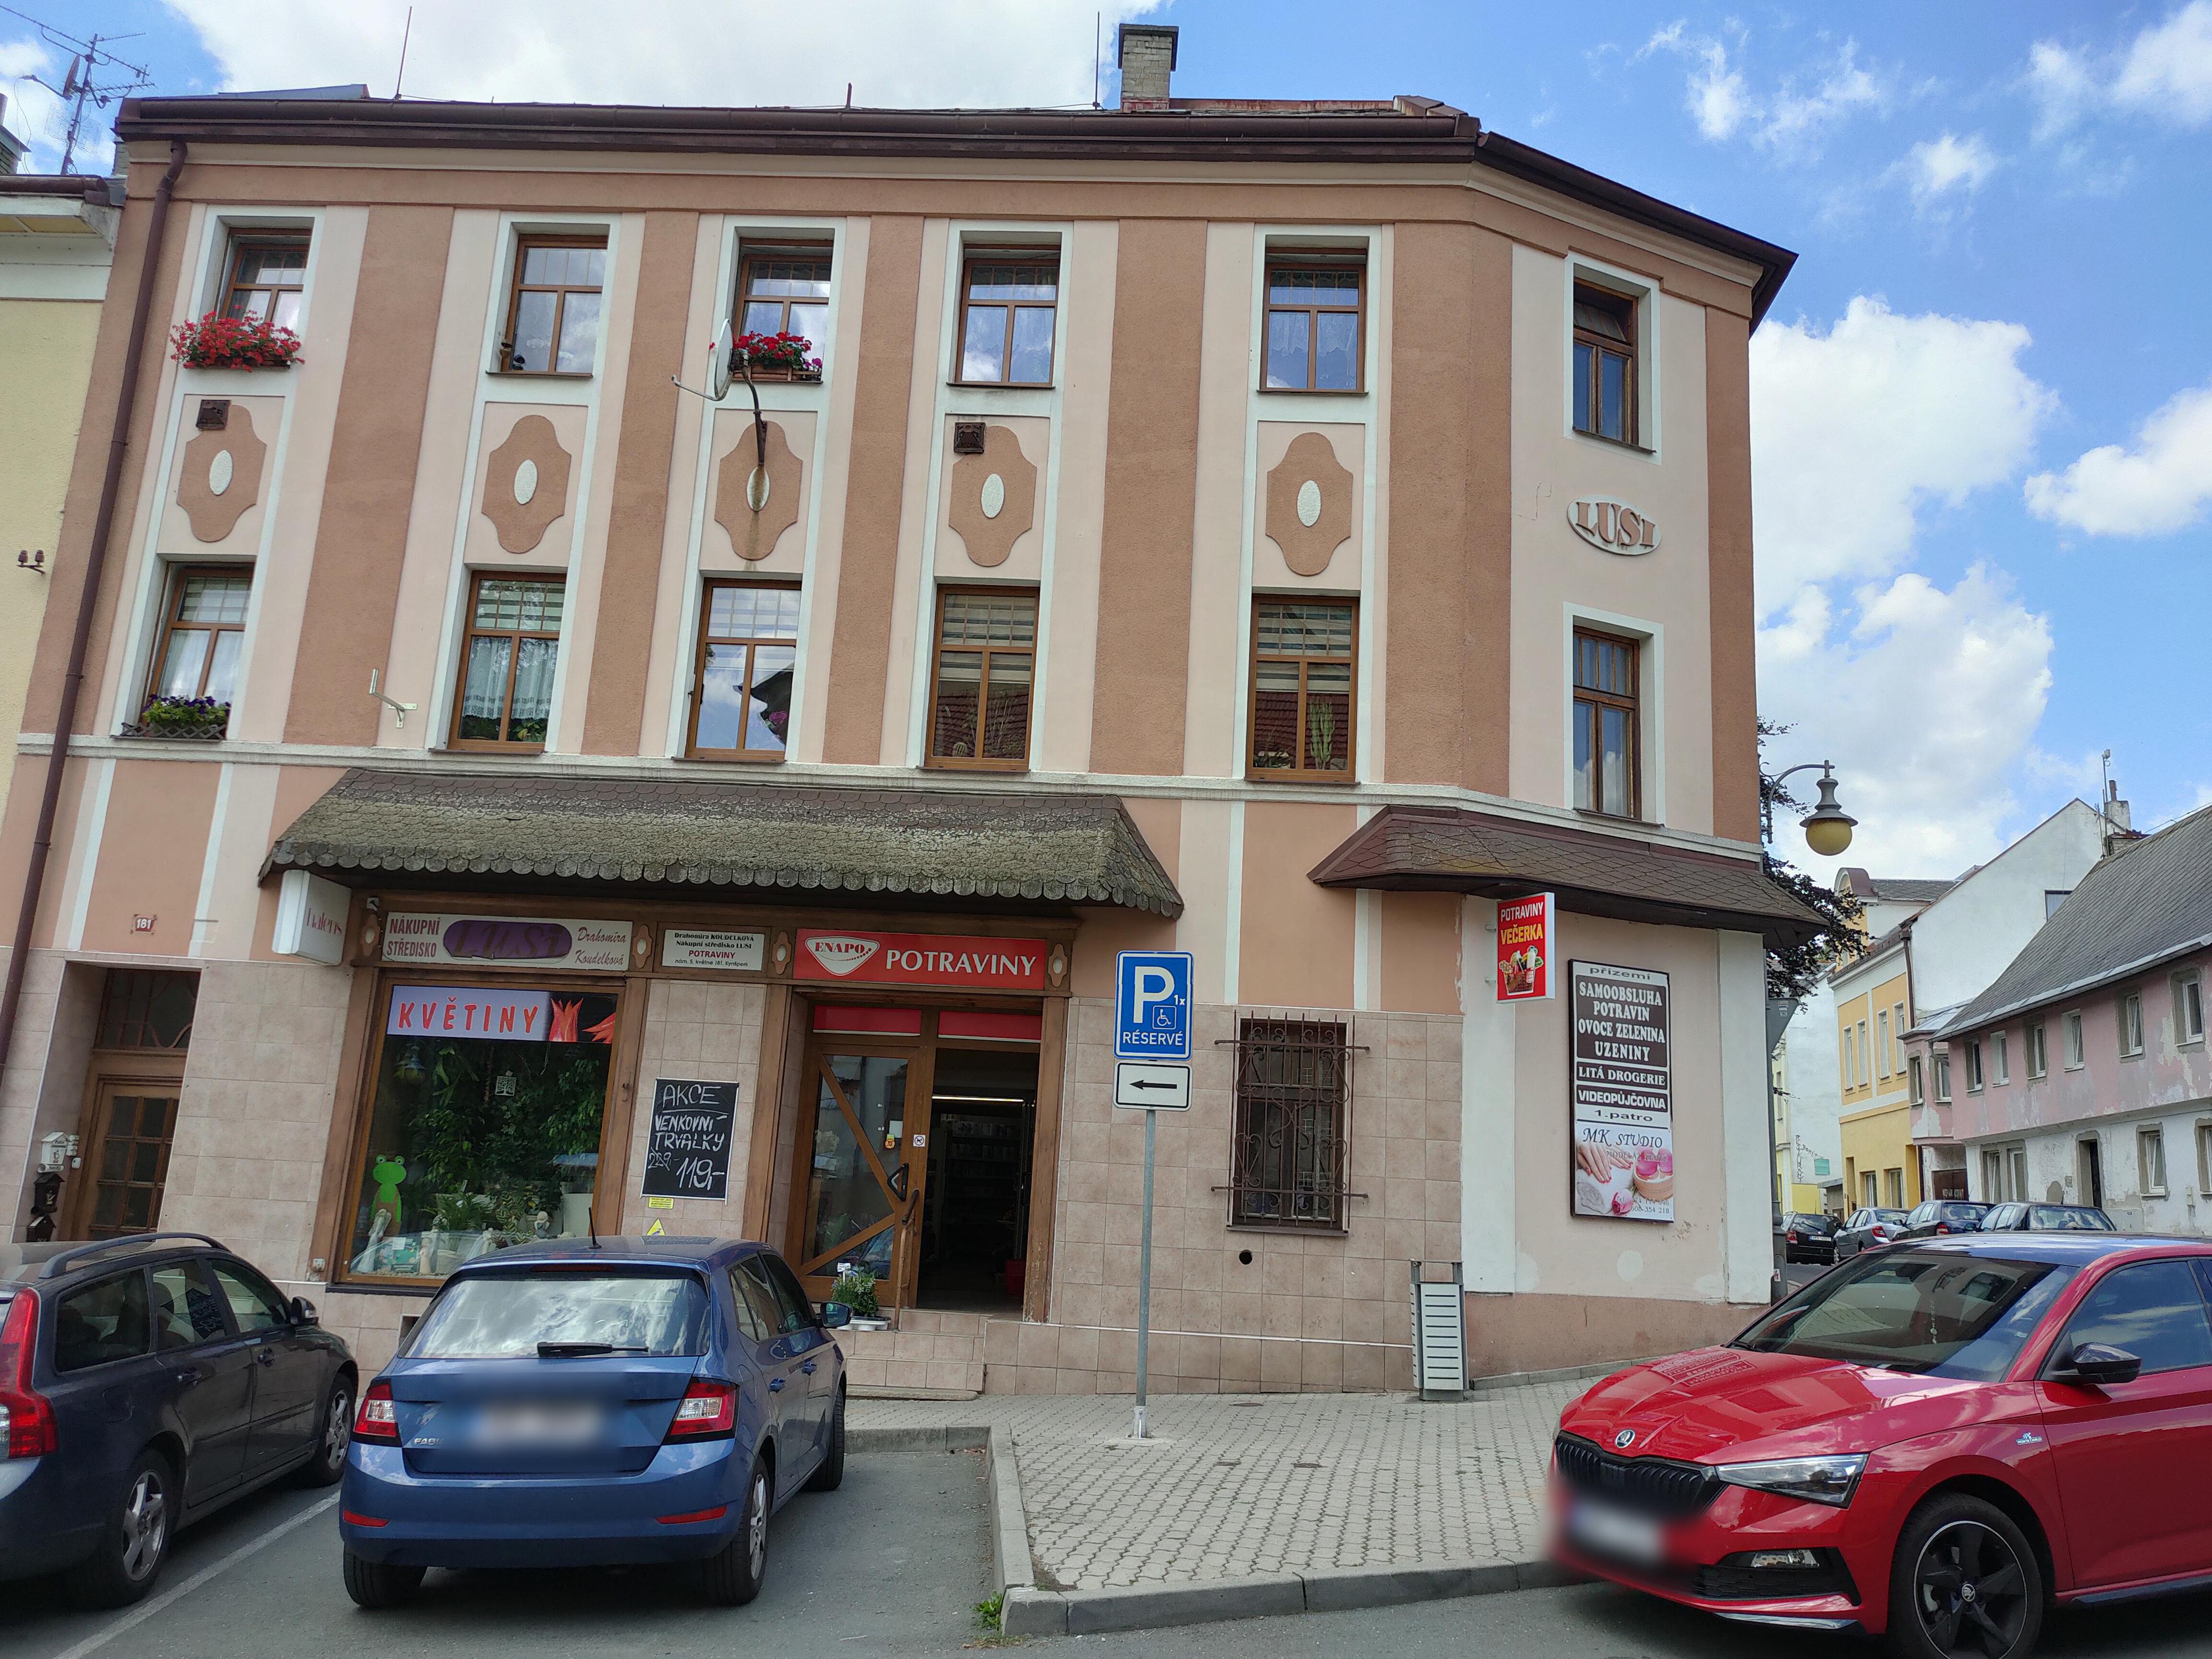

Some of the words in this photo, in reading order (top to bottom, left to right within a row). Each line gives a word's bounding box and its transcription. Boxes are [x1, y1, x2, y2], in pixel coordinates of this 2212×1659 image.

[1575, 502, 1656, 547] LUSI
[1500, 902, 1544, 922] POTRAVINY
[137, 918, 152, 929] 181
[389, 915, 441, 935] NÁKUPNÍ
[577, 926, 627, 943] Drahomíra
[1500, 923, 1543, 945] VEČERKA
[387, 938, 437, 958] STŘEDISKO
[575, 950, 624, 965] Koudelková
[688, 950, 736, 959] POTRAVINY
[814, 941, 866, 954] ENAPO
[886, 949, 1037, 976] POTRAVINY
[1590, 967, 1651, 980] přízemí
[1133, 966, 1175, 1024] P
[1173, 994, 1186, 1005] 1x
[1579, 981, 1663, 1006] SAMOOBSLUHA
[398, 996, 539, 1034] KVĚTINY
[1593, 1000, 1650, 1022] POTRAVIN
[1122, 1029, 1183, 1046] RÉSERVÉ
[1578, 1018, 1614, 1037] OVOCE
[1615, 1023, 1666, 1044] ZELENINA
[1594, 1040, 1651, 1062] UZENINY
[1578, 1065, 1605, 1079] LITÁ
[1608, 1068, 1666, 1086] DROGERIE
[662, 1084, 722, 1108] AKCE
[1578, 1089, 1667, 1109] VIDEOPŮJČOVNA
[655, 1114, 727, 1132] VENKOVNÍ
[1594, 1109, 1653, 1122] 1.patro
[655, 1132, 725, 1151] TRVALKY
[1583, 1128, 1612, 1147] MK
[1615, 1133, 1663, 1148] STUDIO
